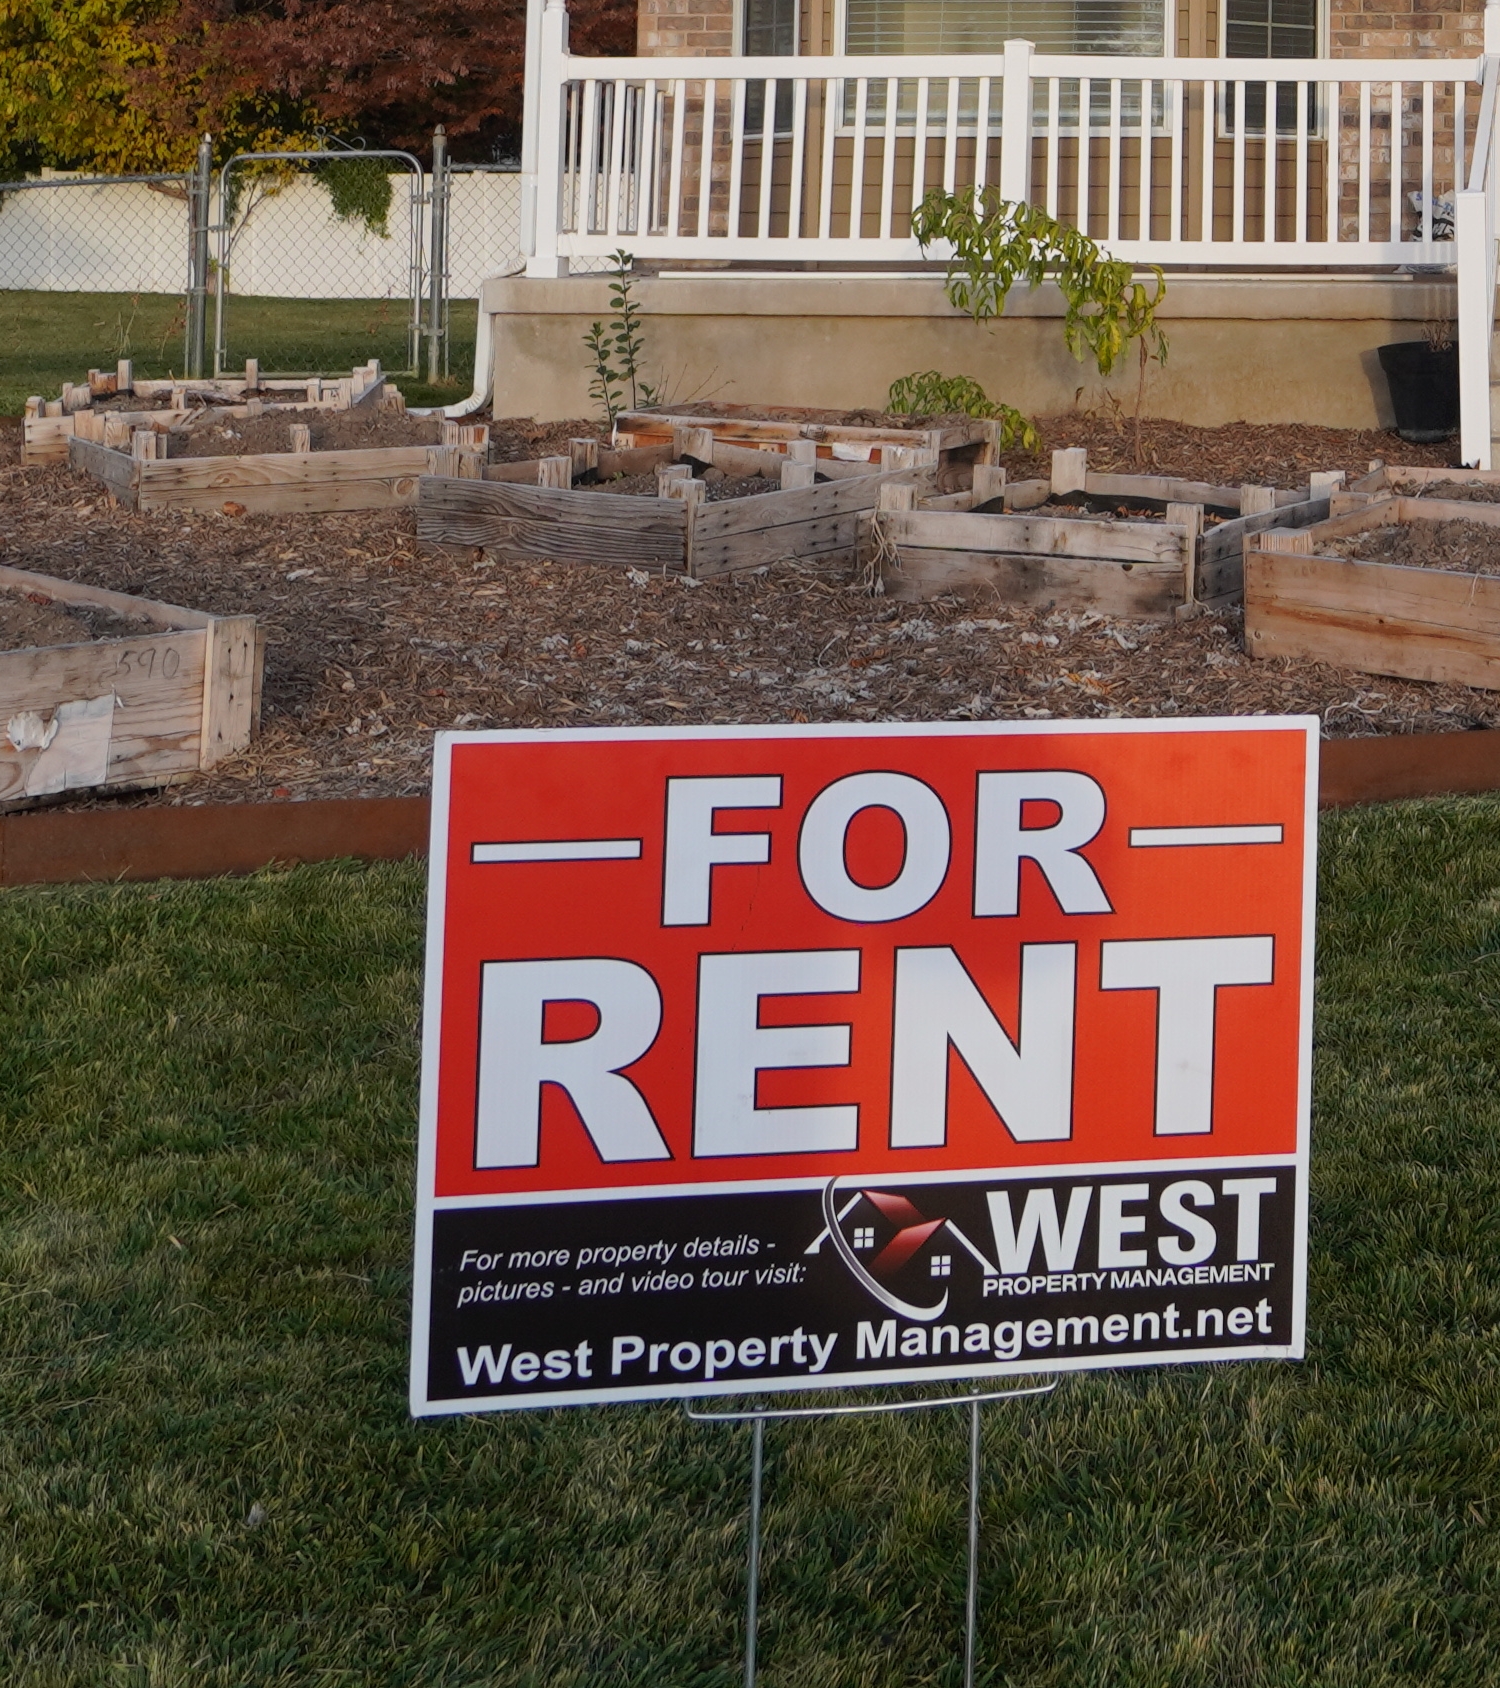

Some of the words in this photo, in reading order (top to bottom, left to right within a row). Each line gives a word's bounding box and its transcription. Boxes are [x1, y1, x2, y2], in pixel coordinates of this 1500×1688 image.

[660, 769, 1116, 927] FOR
[472, 934, 1276, 1172] RENT
[459, 1249, 503, 1272] For
[507, 1245, 570, 1269] more
[576, 1239, 677, 1269] property
[683, 1234, 760, 1259] details
[986, 1177, 1277, 1275] WEST
[456, 1279, 554, 1308] pictures
[577, 1273, 624, 1296] and
[630, 1270, 694, 1293] video
[701, 1266, 749, 1289] tour
[754, 1262, 807, 1286] visit:
[982, 1272, 1106, 1297] PROPERTY
[1110, 1262, 1276, 1289] MANAGEMENT
[456, 1339, 593, 1386] West
[611, 1326, 838, 1379] Property
[856, 1297, 1273, 1360] Management.net
